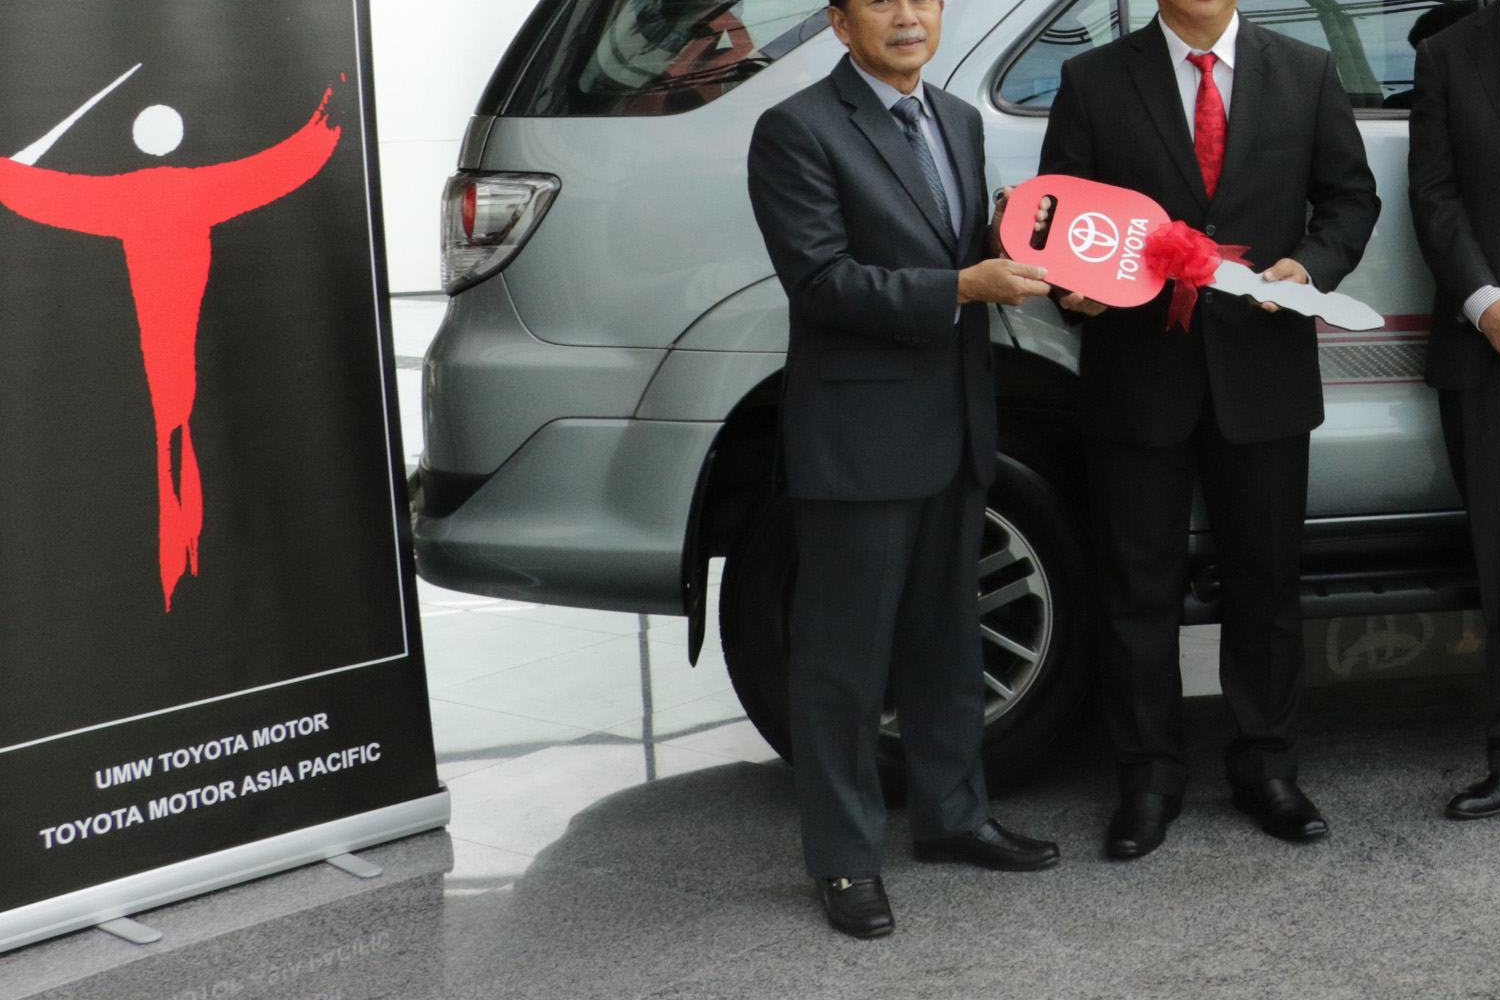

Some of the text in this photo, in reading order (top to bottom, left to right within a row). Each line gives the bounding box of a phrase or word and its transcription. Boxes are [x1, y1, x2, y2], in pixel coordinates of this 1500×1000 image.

[1116, 218, 1149, 281] TOYOTA
[95, 712, 330, 790] UMW TOYOTA MOTOR
[40, 742, 381, 849] TOYOTA MOTOR ASIA PACIFIC
